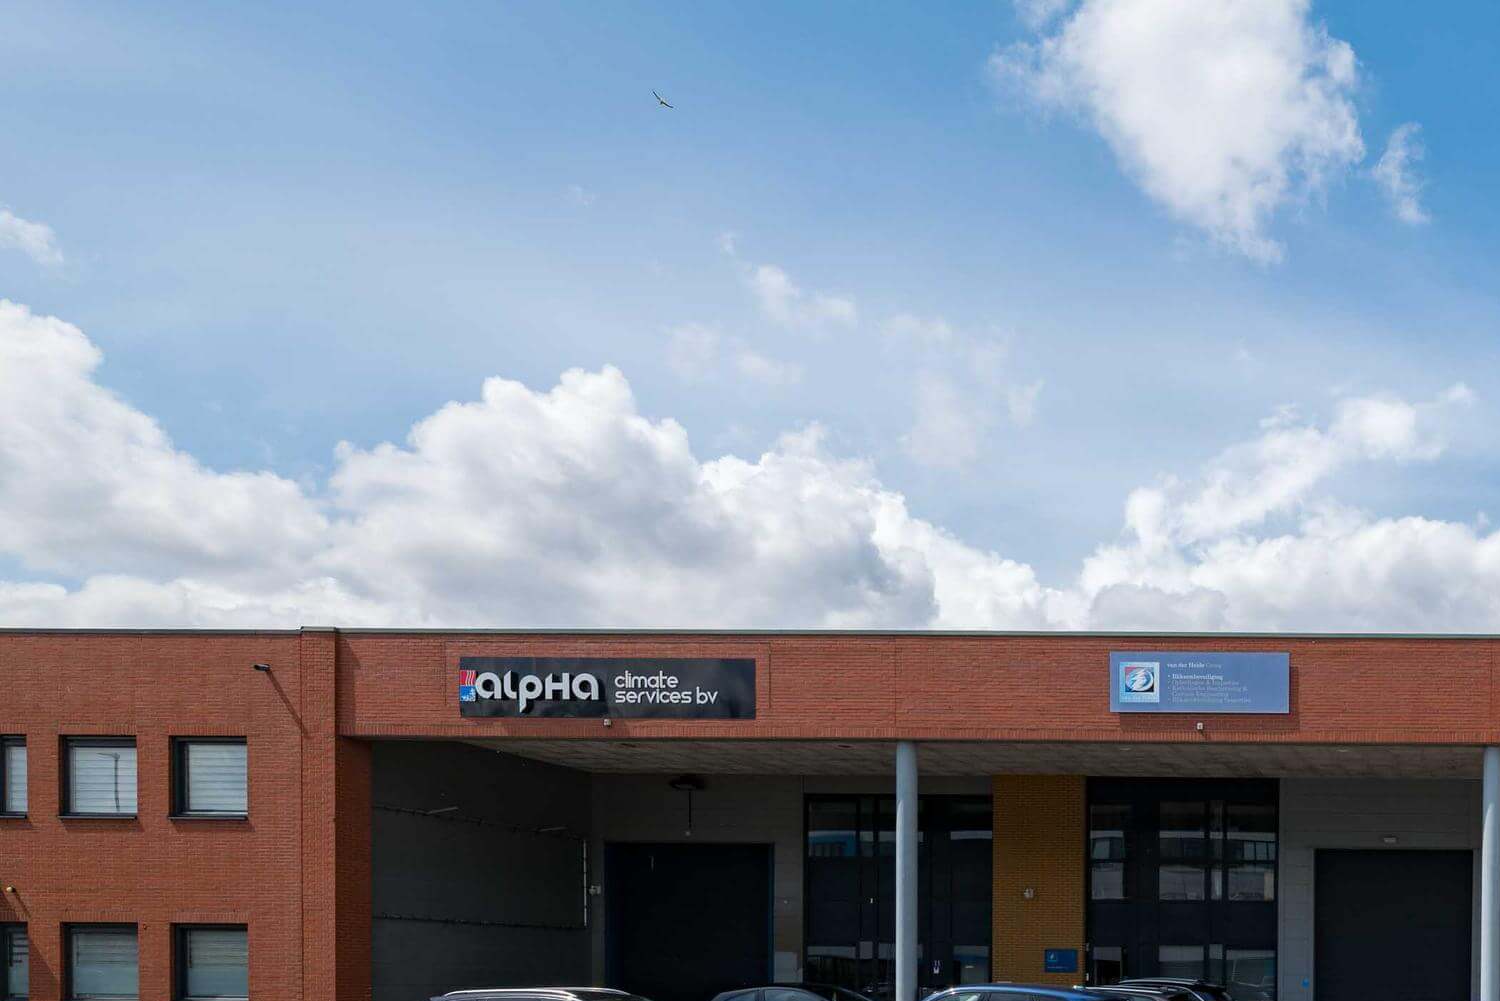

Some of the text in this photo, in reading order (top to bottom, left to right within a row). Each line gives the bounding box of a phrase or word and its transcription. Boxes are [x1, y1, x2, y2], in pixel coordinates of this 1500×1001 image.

[614, 670, 679, 689] climate
[615, 686, 718, 704] services bv
